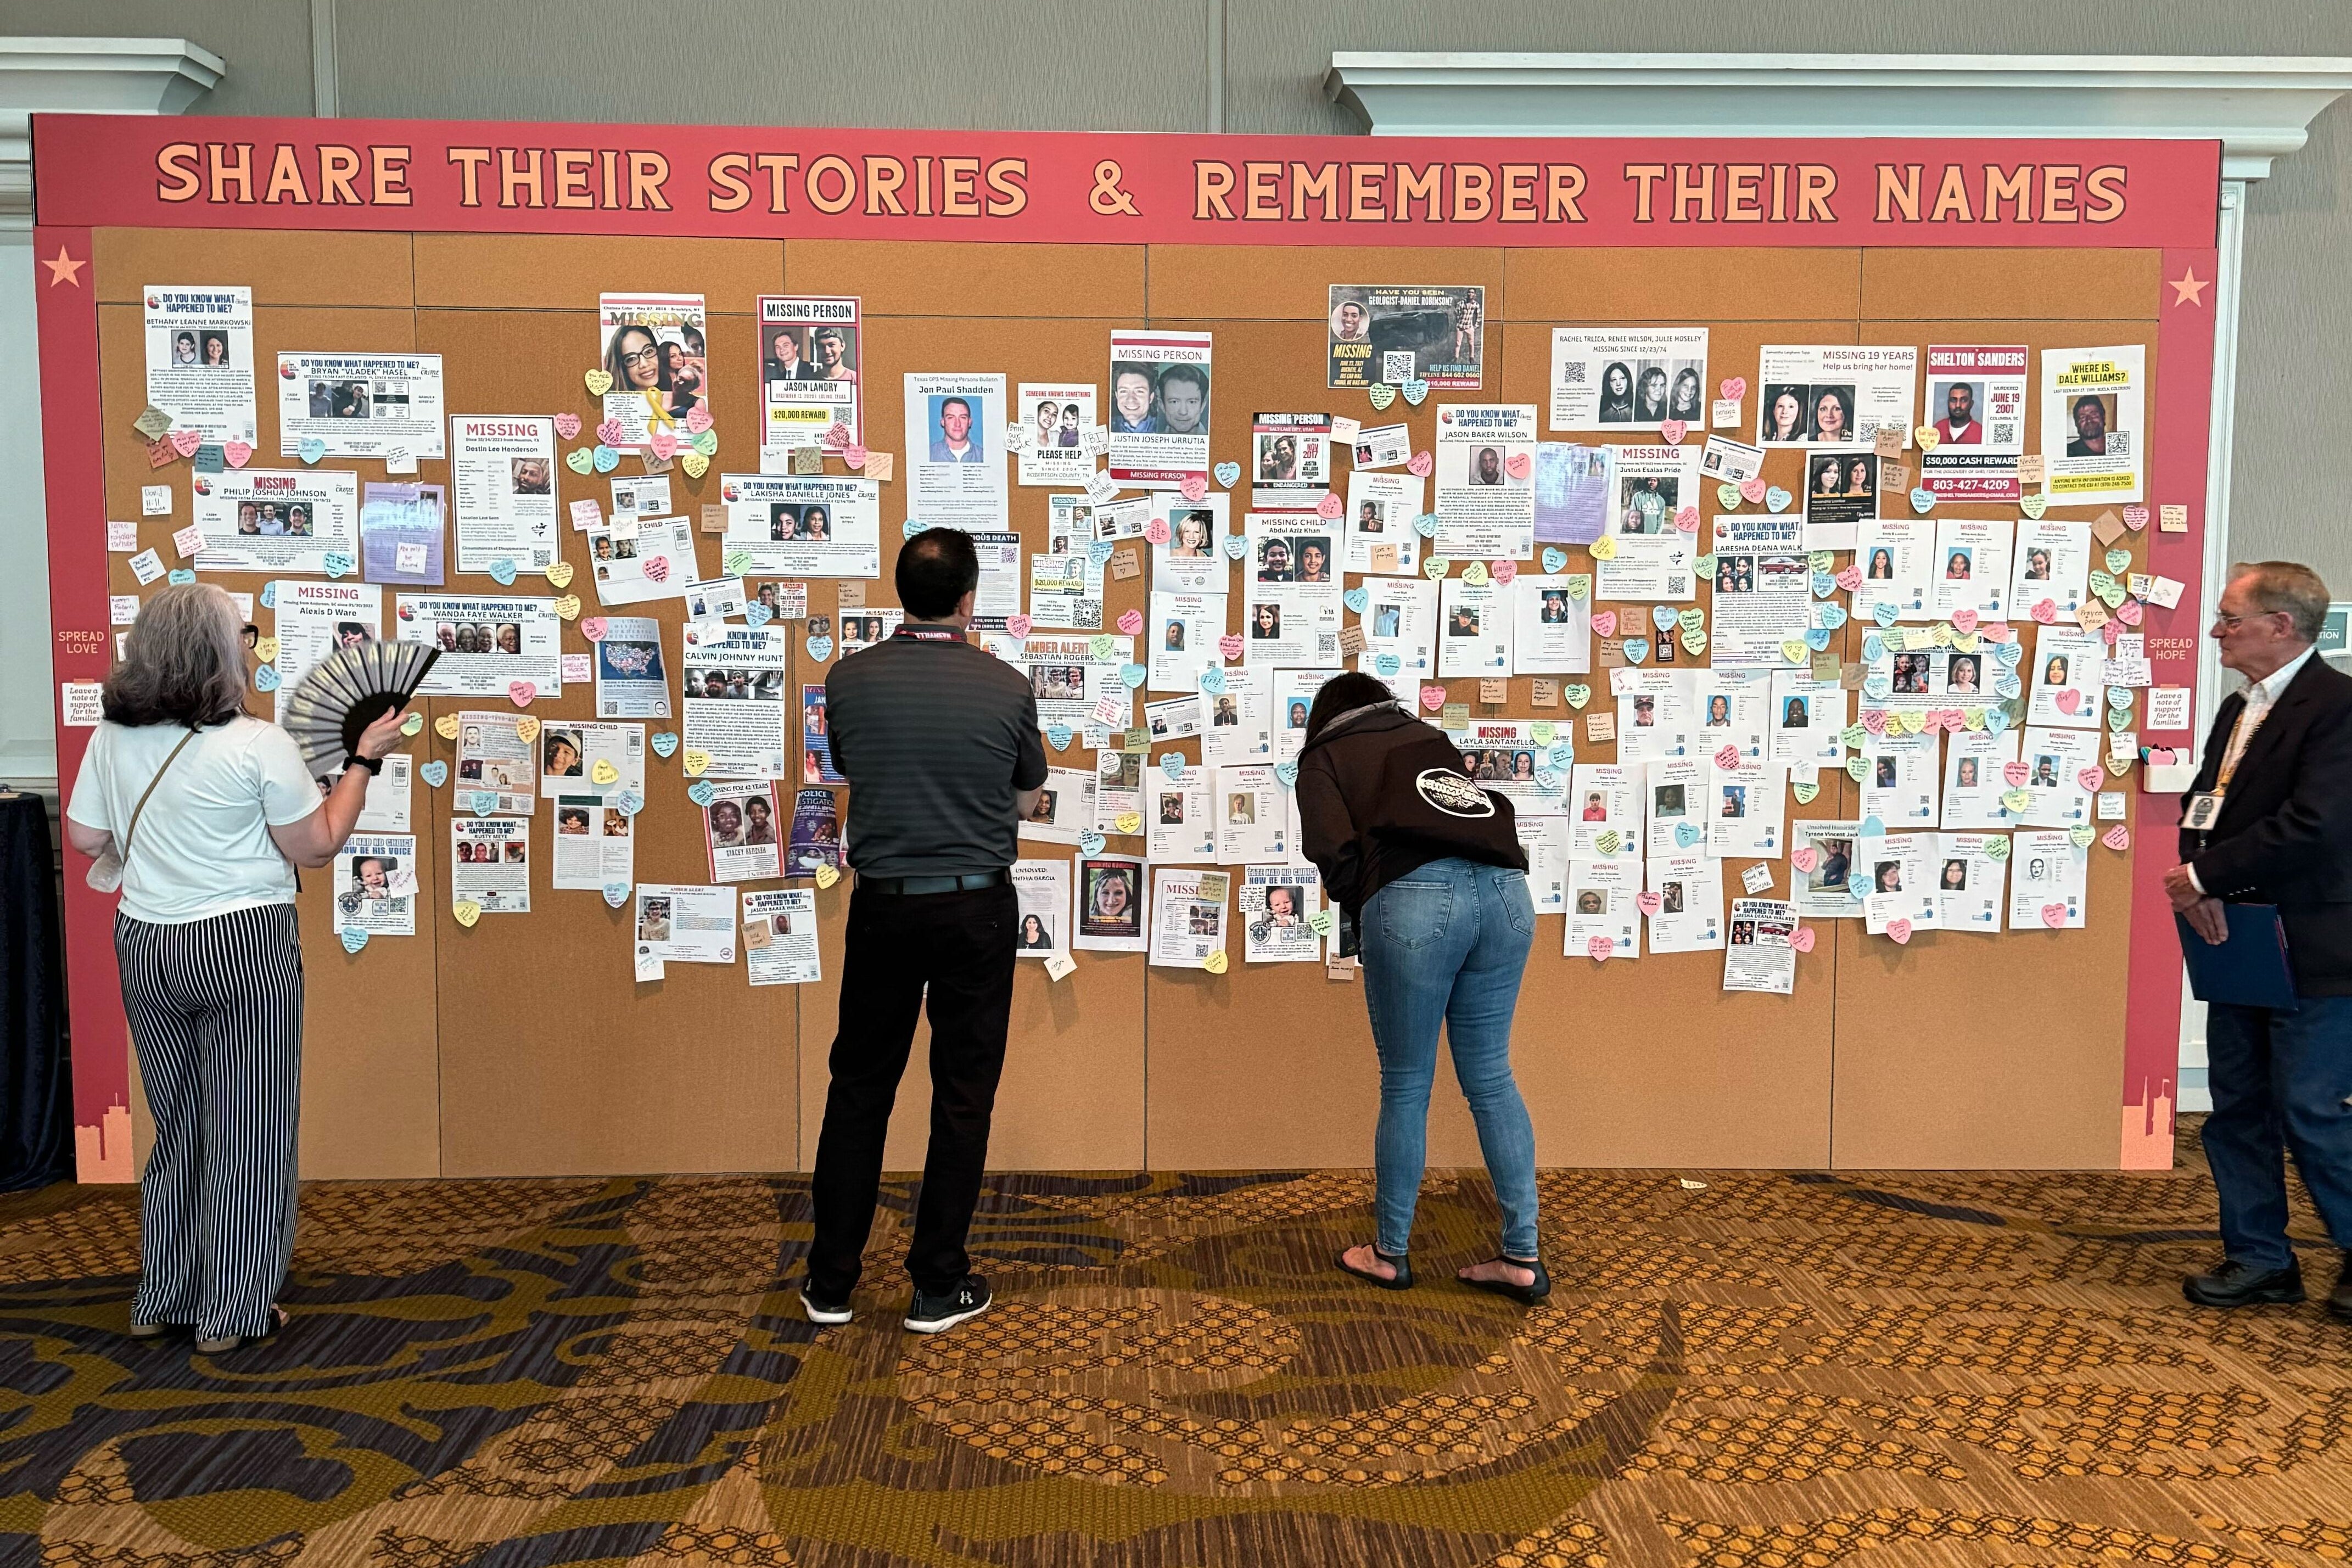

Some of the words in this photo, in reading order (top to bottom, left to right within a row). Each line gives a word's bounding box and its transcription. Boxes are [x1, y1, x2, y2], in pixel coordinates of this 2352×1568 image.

[154, 141, 414, 208] SHARE
[445, 145, 674, 211] THEIR
[707, 152, 1028, 218] STORIES
[1087, 158, 1144, 217] &
[1190, 157, 1589, 228] REMEMBER
[1623, 163, 1838, 223] THEIR
[1873, 163, 2127, 224] NAMES
[163, 294, 172, 303] DO
[175, 294, 189, 303] YOU
[191, 294, 212, 303] KNOW
[214, 294, 234, 303] WHAT
[1368, 296, 1420, 306] GEOLOGIST-DANIEL
[1421, 296, 1453, 306] ROBINSON?
[166, 304, 205, 312] HAPPENED
[206, 304, 215, 313] TO
[217, 304, 232, 313] ME?
[766, 304, 810, 317] MISSING
[813, 305, 852, 318] PERSON
[611, 312, 701, 327] MISSING
[1118, 350, 1160, 359] MISSING
[1163, 350, 1202, 360] PERSON
[1333, 344, 1372, 358] MISSING
[1823, 351, 1865, 360] MISSING
[1868, 351, 1879, 360] 19
[1882, 351, 1914, 360] YEARS
[1930, 353, 1974, 366] SHELTON
[1978, 352, 2024, 366] SANDERS
[1823, 362, 1841, 371] Help
[1853, 363, 1873, 371] bring
[2072, 364, 2099, 373] WHERE
[2102, 363, 2109, 372] IS
[2059, 374, 2079, 384] DALE
[2081, 372, 2126, 383] WILLIAMS?
[783, 382, 807, 391] JASON
[810, 382, 837, 391] LANDRY
[936, 385, 955, 394] Paul
[956, 385, 993, 394] Shadden
[1991, 393, 2009, 402] JUNE
[2012, 394, 2020, 402] 19
[1996, 405, 2014, 413] 2001
[774, 410, 799, 419] $20,000
[801, 410, 826, 419] REWARD
[1259, 414, 1292, 424] MISSING
[1294, 414, 1324, 424] PERSON
[466, 424, 538, 436] MISSING
[1082, 432, 1104, 443] TBI
[1037, 450, 1062, 459] PLEASE
[1065, 450, 1082, 459] HELP
[1085, 444, 1107, 456] HELP
[1622, 449, 1679, 459] MISSING
[254, 477, 296, 490] MISSING
[1933, 480, 2009, 490] 803-427-4209
[224, 489, 251, 497] PHILIP
[252, 489, 284, 497] JOSHUA
[285, 490, 327, 498] JOHNSON
[298, 587, 359, 600] MISSING
[58, 631, 104, 641] SPREAD
[66, 643, 98, 653] LOVE
[1024, 641, 1058, 653] AMBER
[1060, 642, 1089, 653] ALERT
[2149, 638, 2193, 648] SPREAD
[719, 653, 755, 662] JOHNNY
[2156, 650, 2186, 659] HOPE
[2155, 712, 2166, 720] for
[1478, 727, 1516, 738] MISSING
[2036, 833, 2063, 841] MISSING
